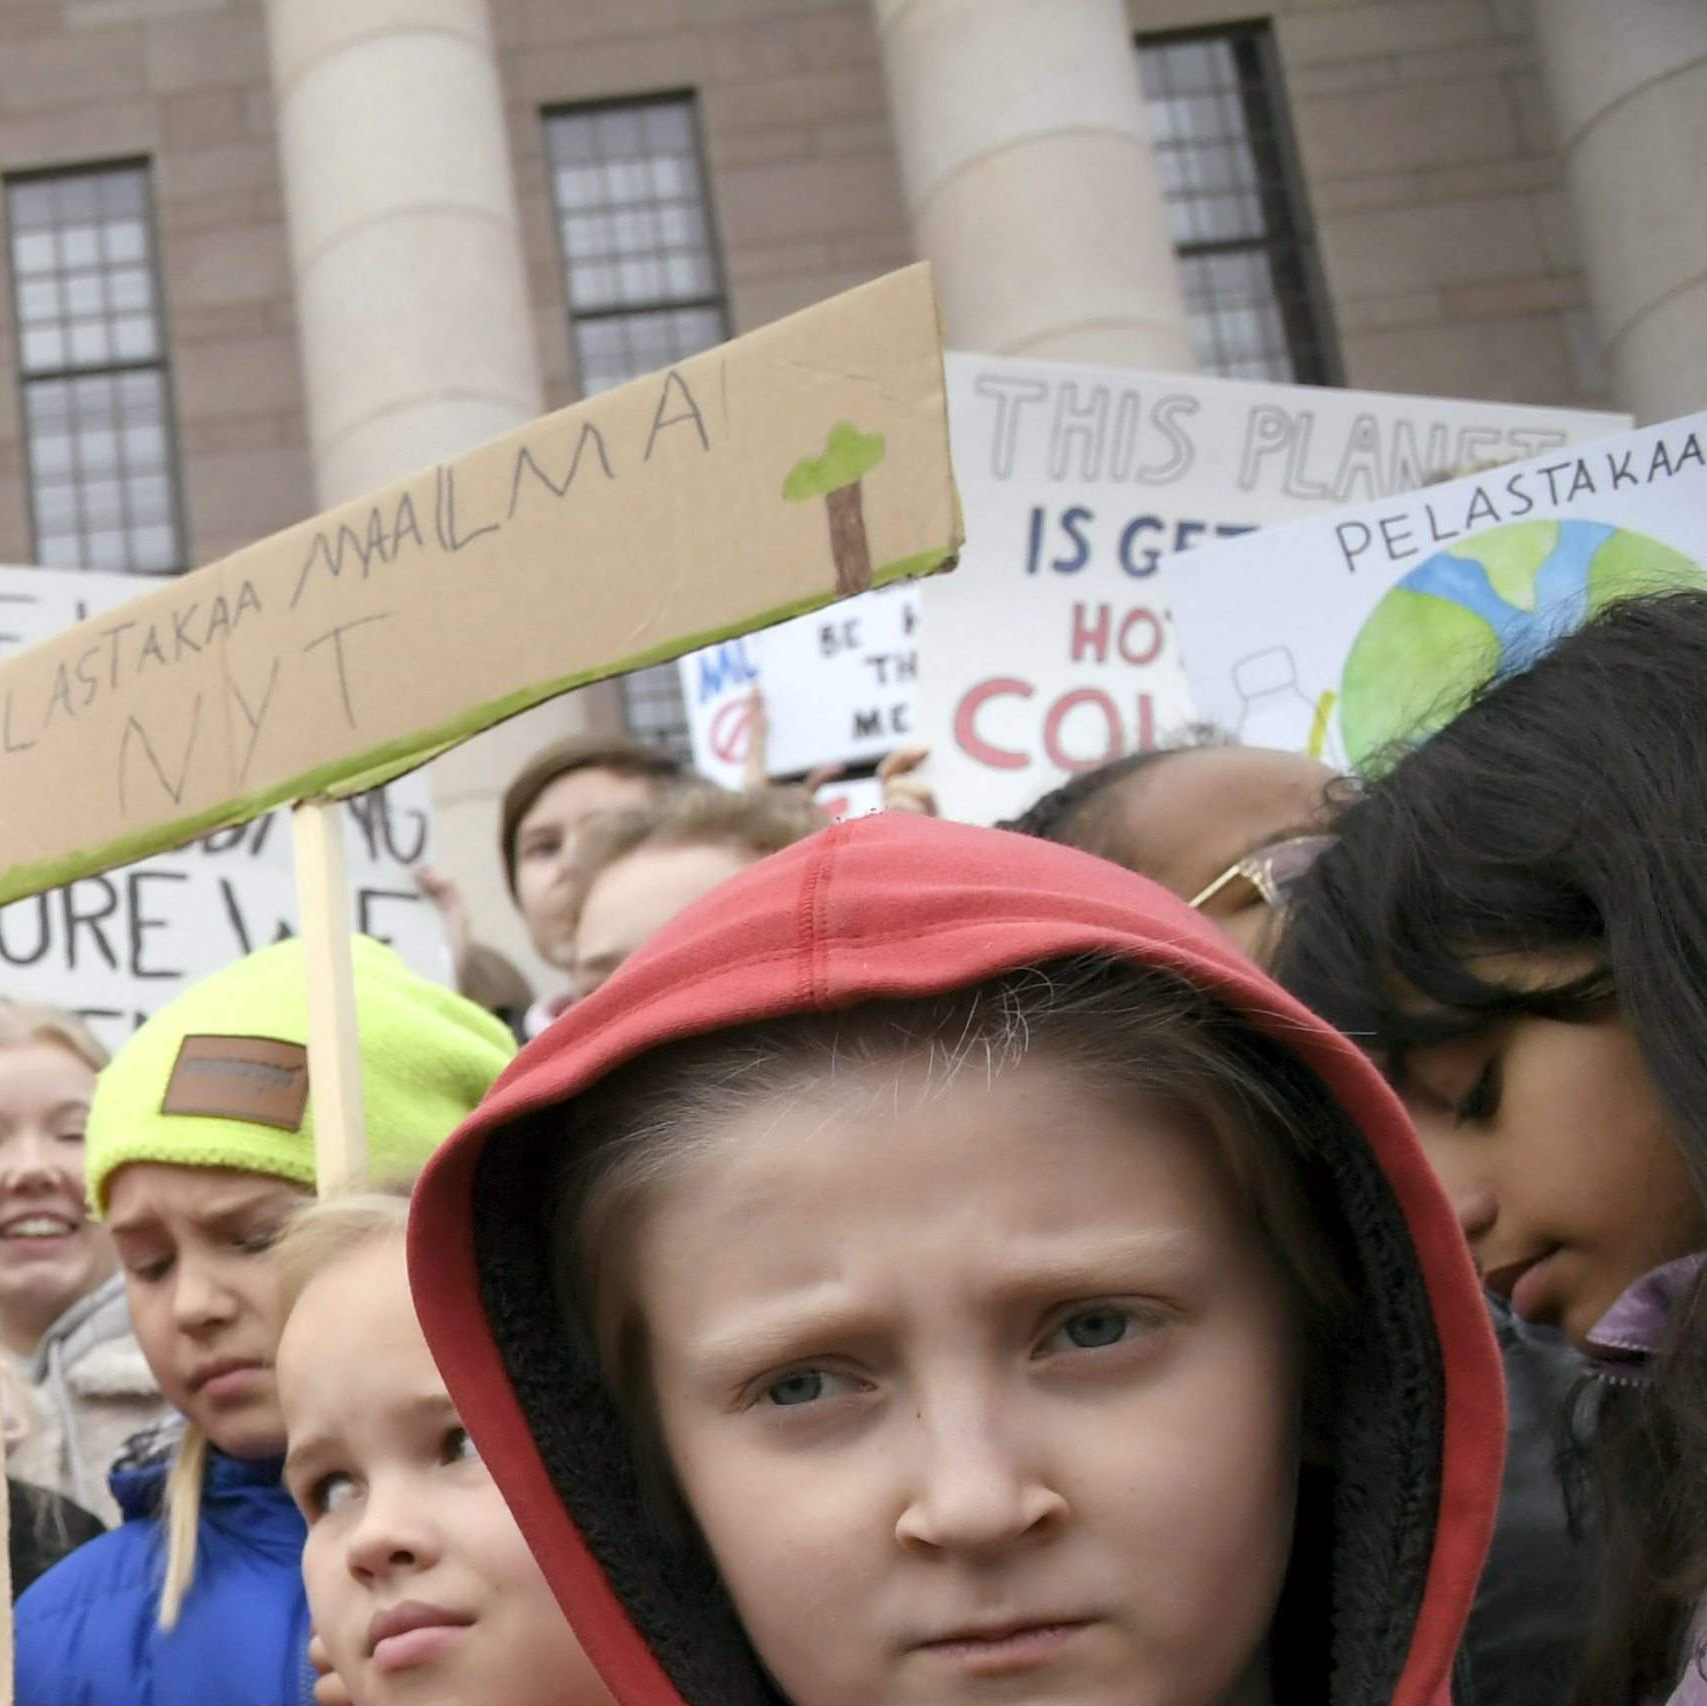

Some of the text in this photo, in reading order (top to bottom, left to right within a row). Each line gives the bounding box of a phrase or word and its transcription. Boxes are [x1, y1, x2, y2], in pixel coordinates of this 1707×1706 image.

[975, 374, 1201, 485] THIS
[1025, 505, 1097, 575] IS
[1333, 432, 1706, 573] PELASTAKAA
[117, 610, 399, 816] NYT
